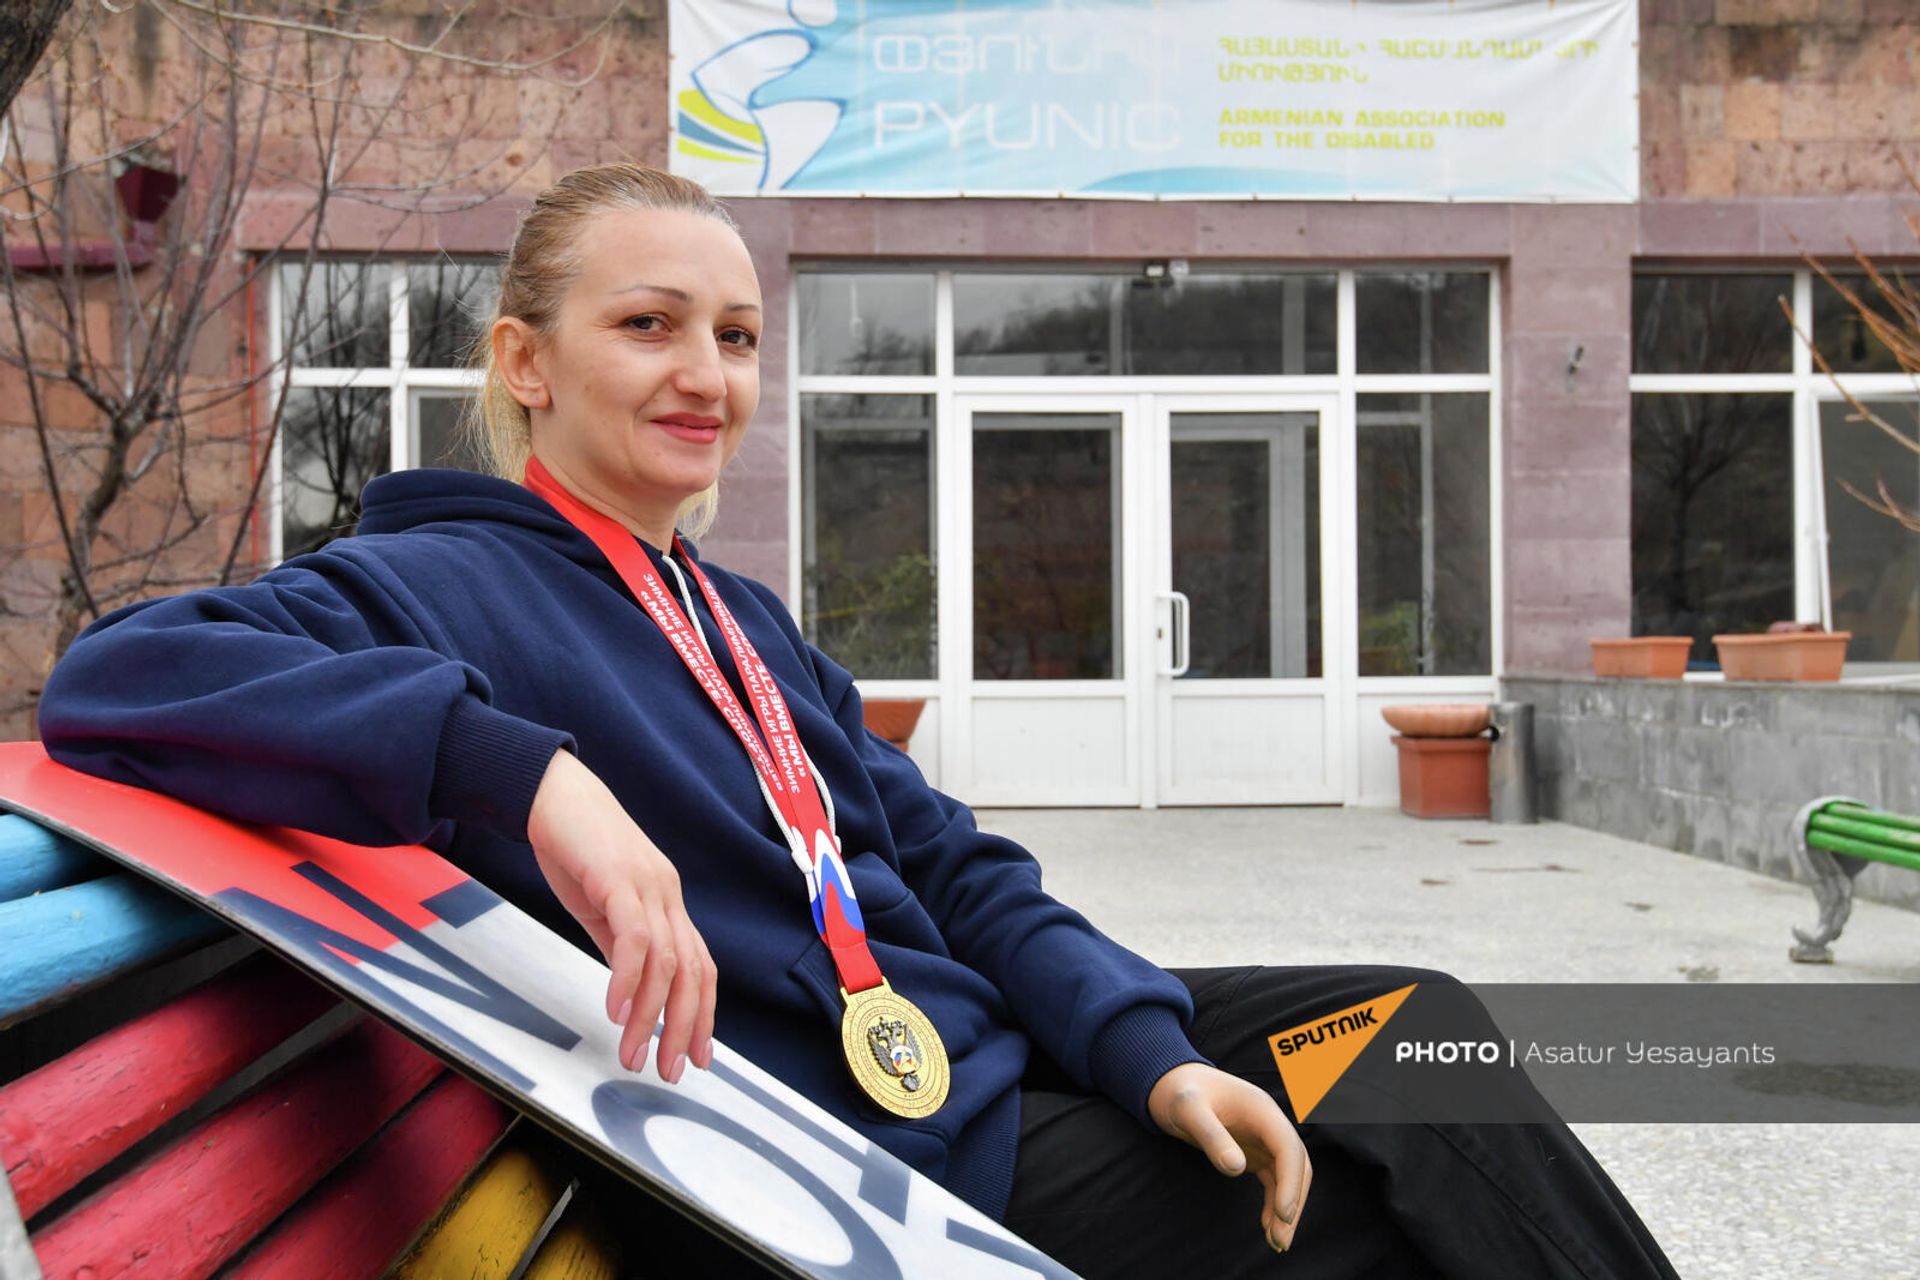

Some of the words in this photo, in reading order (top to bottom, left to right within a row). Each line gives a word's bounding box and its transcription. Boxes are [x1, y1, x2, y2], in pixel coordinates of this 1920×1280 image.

[1219, 35, 1367, 58] ՀԱՅԱՍՏԱՆ
[873, 100, 1182, 152] PYUNIC
[1219, 108, 1343, 127] ARMENIAN
[1355, 109, 1505, 128] ASSOCIATION
[1219, 130, 1262, 149] FOR
[1273, 131, 1313, 149] THE
[1326, 131, 1436, 150] DISABLED
[640, 590, 675, 631] «МЫ
[643, 573, 685, 629] ЗИМНИЕ
[680, 630, 710, 667] ИГРЫ
[755, 695, 779, 733] ИГРЫ
[771, 735, 801, 794] ЗИМНИЕ
[783, 734, 807, 778] «МЫ
